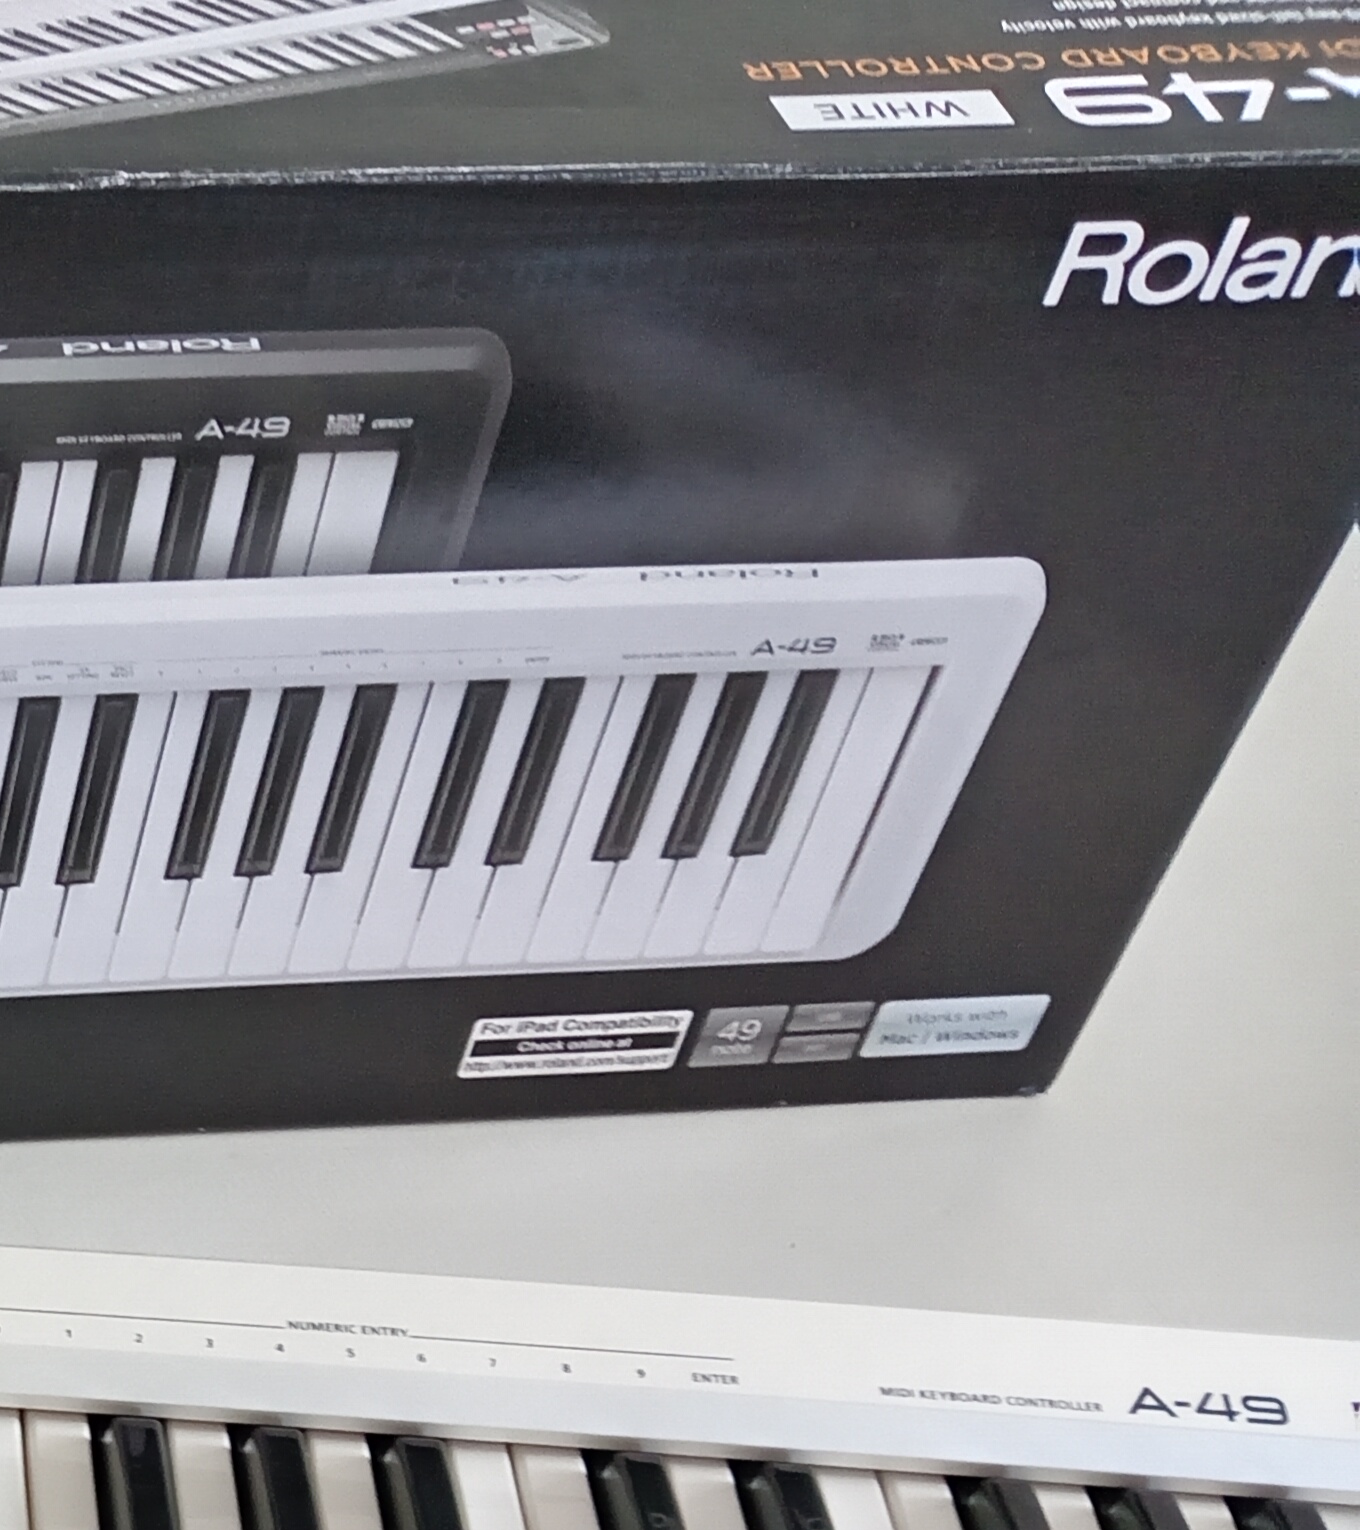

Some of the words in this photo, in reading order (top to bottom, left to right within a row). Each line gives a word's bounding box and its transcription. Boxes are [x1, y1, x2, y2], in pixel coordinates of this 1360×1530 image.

[1001, 19, 1077, 34] velocity
[1080, 16, 1123, 30] with
[743, 52, 1045, 80] CONTROLLER
[1061, 41, 1311, 69] KEYBOARD
[812, 101, 971, 122] WHITE
[1042, 214, 1360, 311] Rolan
[62, 336, 264, 358] Roland
[194, 416, 291, 441] A-49
[749, 635, 836, 656] A-49
[480, 1023, 514, 1036] For
[515, 1019, 560, 1034] iPad
[562, 1015, 684, 1034] Compatibility
[715, 1018, 763, 1042] 49
[879, 1032, 919, 1045] Mac
[935, 1028, 1019, 1043] Windows
[516, 1040, 566, 1053] Check
[566, 1037, 616, 1051] online
[287, 1321, 356, 1334] NUMERIC
[361, 1325, 407, 1336] ENTRY
[134, 1333, 143, 1343] 2
[206, 1338, 213, 1348] 3
[276, 1344, 284, 1352] 4
[346, 1348, 355, 1358] 5
[417, 1354, 426, 1362] 6
[489, 1358, 496, 1367] 7
[563, 1364, 571, 1373] 8
[637, 1369, 646, 1378] 9
[692, 1373, 738, 1384] ENTER
[879, 1387, 915, 1397] MIDI
[919, 1390, 1002, 1404] KEYBOARD
[1005, 1396, 1103, 1412] CONTROLLER
[1129, 1387, 1290, 1425] A-49
